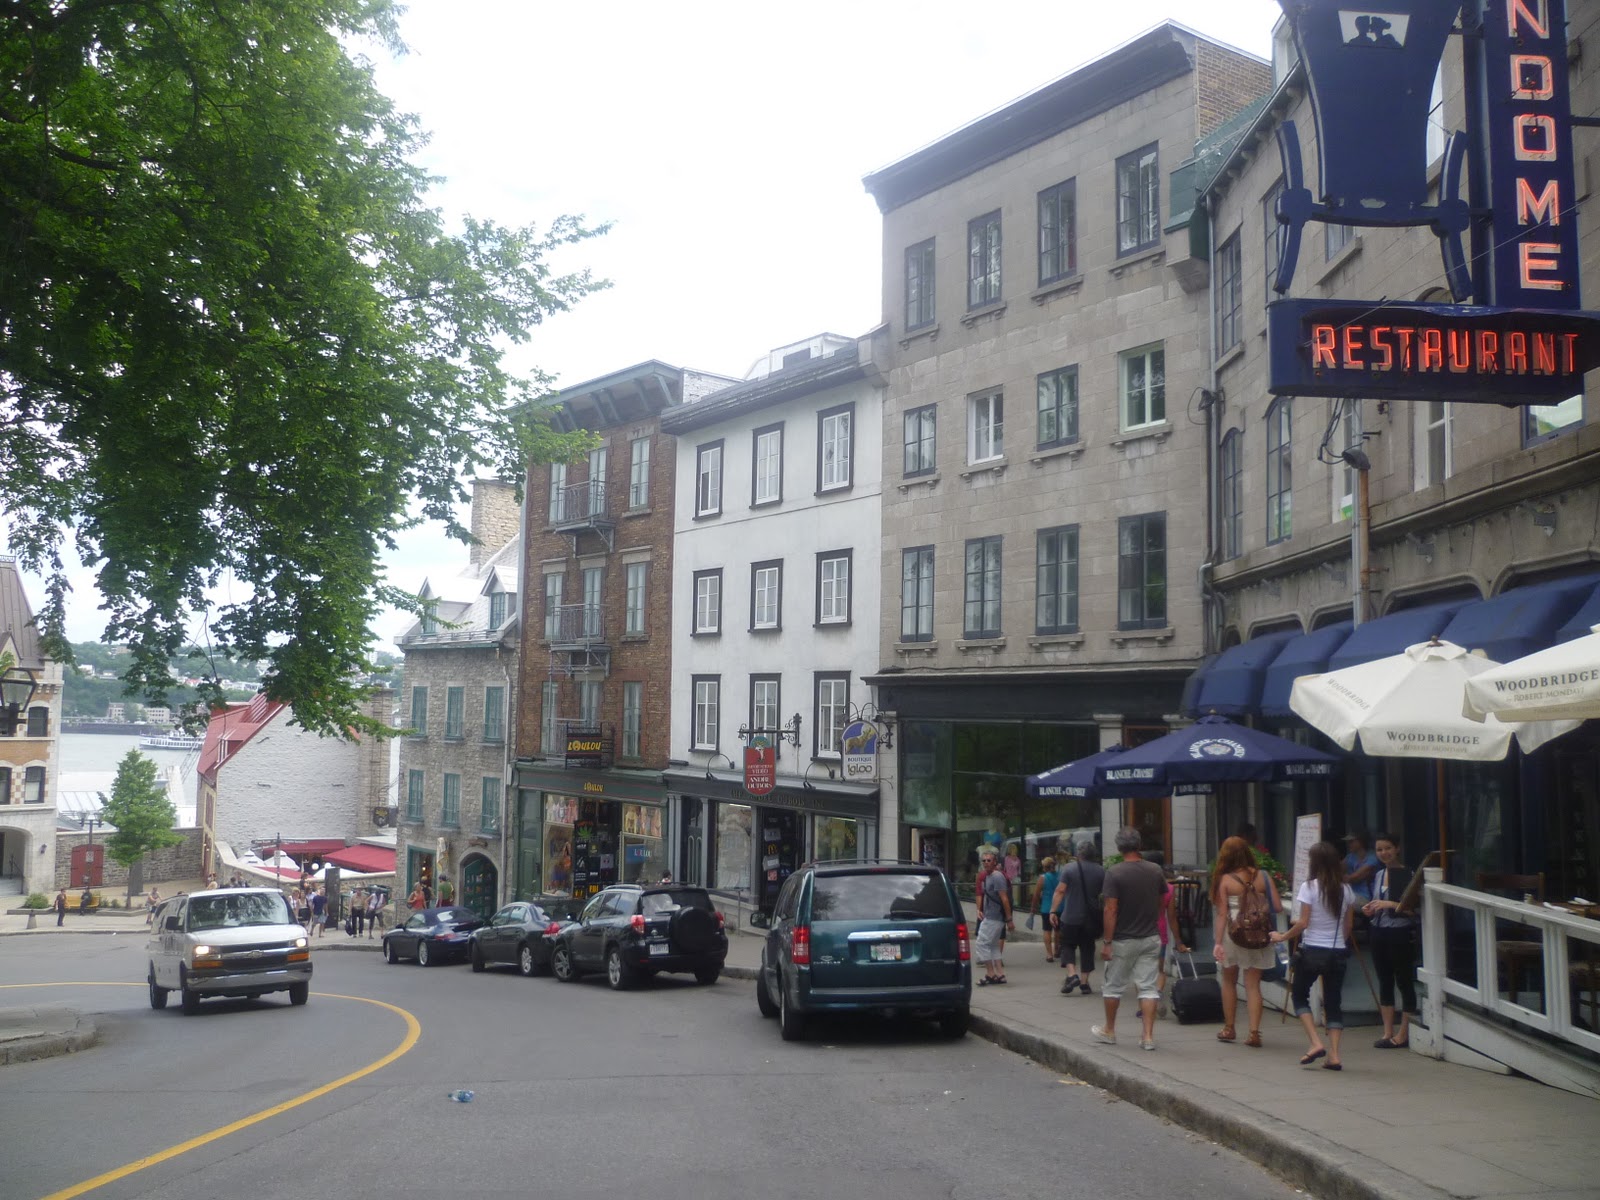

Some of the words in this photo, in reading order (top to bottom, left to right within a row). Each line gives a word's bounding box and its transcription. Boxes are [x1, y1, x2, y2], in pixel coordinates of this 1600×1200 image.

[1312, 324, 1578, 376] RESTAURANT
[1495, 669, 1599, 692] WOODBRIDGE
[567, 740, 602, 751] LOULOU
[1386, 731, 1480, 745] WOODBRIDGE
